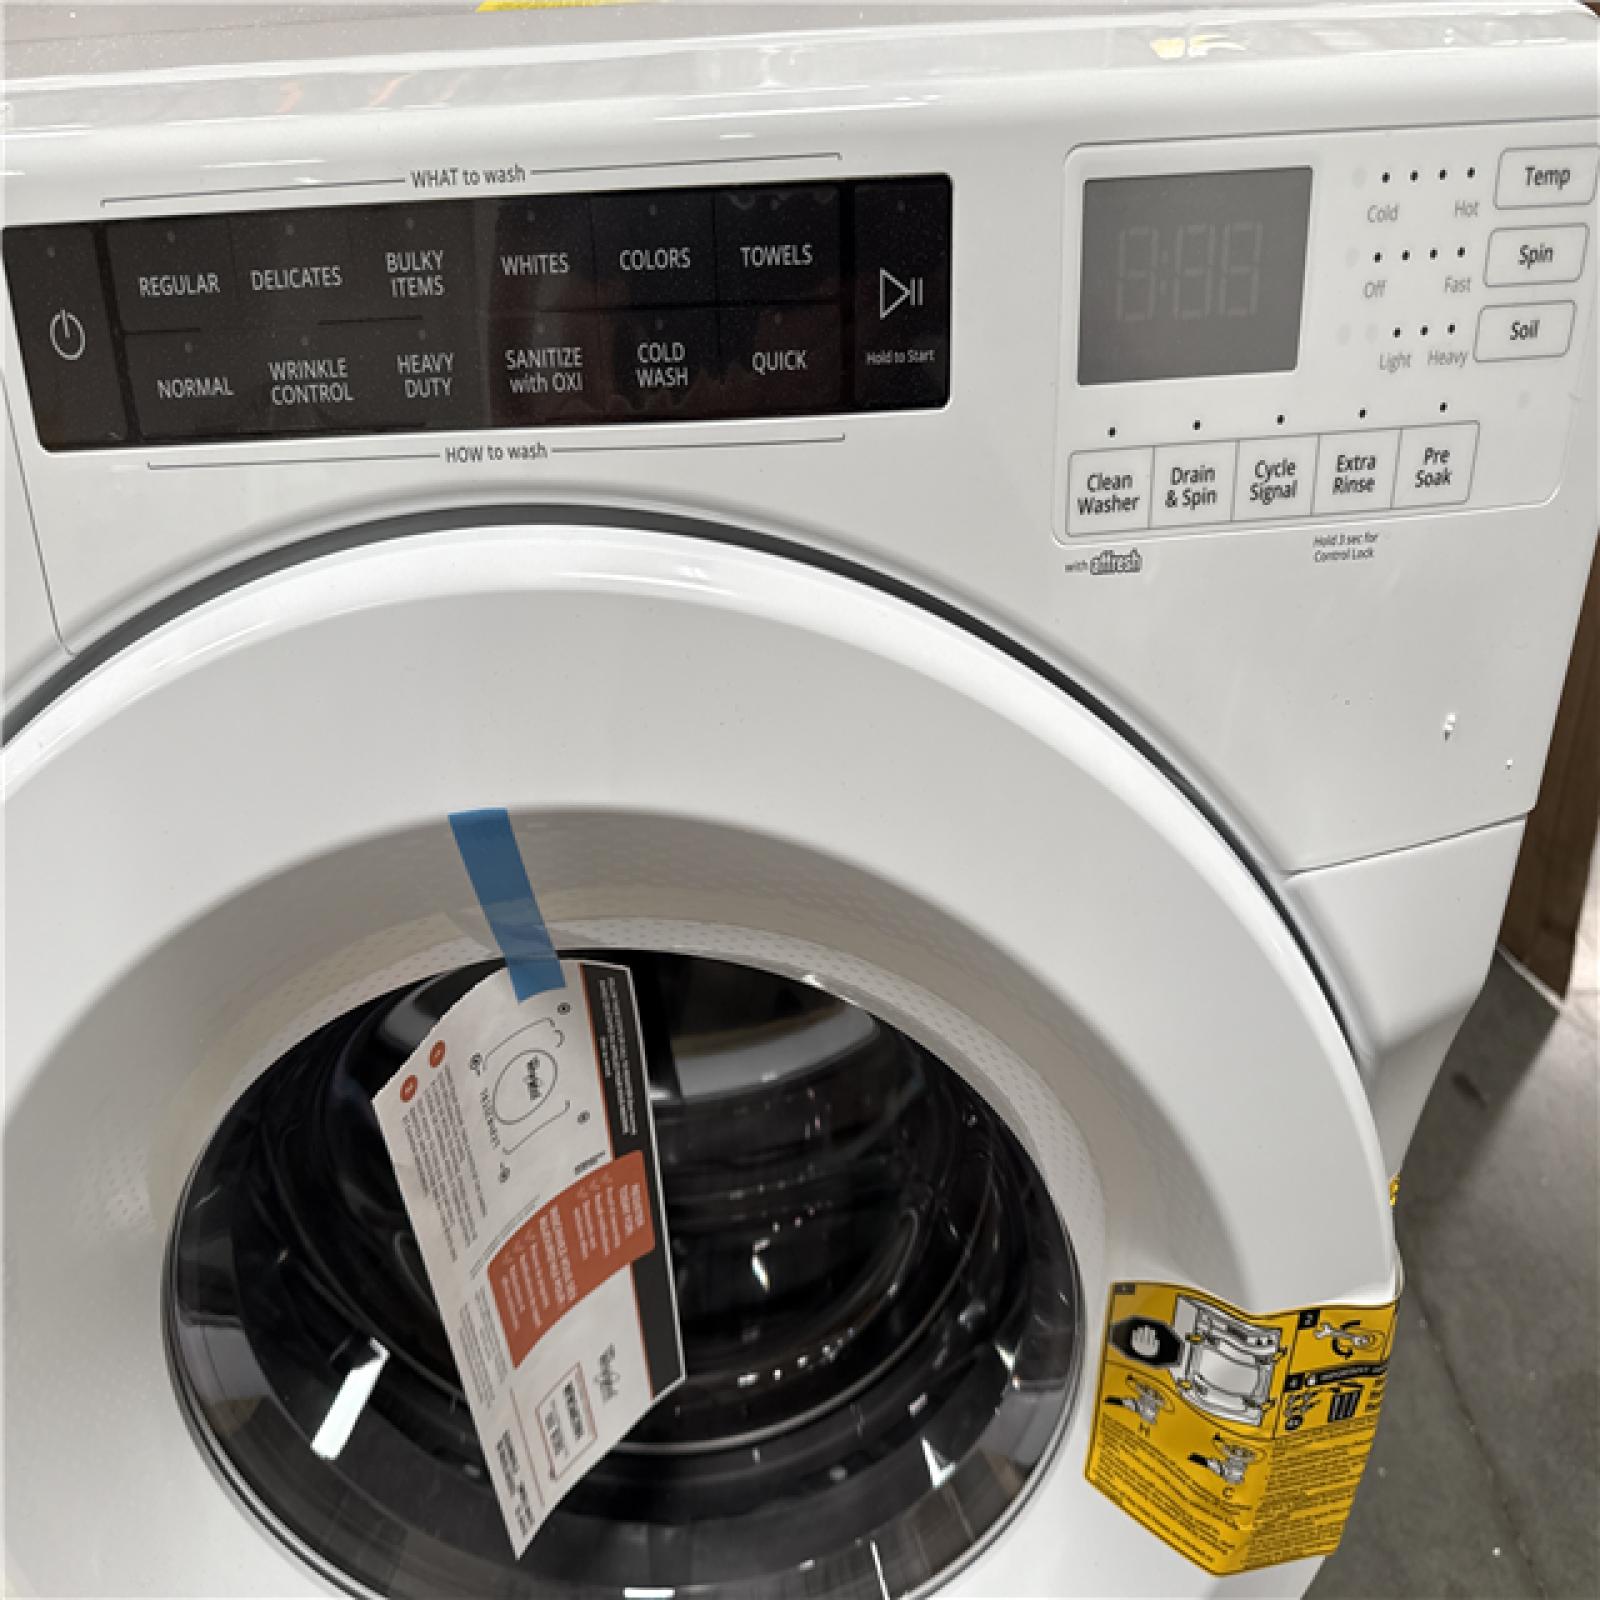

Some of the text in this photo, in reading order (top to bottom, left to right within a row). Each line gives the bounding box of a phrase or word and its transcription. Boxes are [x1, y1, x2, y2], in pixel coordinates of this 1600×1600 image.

[410, 162, 525, 188] WHAT to wash
[1525, 166, 1571, 189] Temp
[1367, 204, 1399, 223] Cold
[1454, 200, 1479, 218] Hot
[386, 250, 444, 273] BULKY
[501, 253, 570, 276] WHITES
[620, 247, 691, 271] COLORS
[740, 244, 813, 267] TOWELS
[1518, 243, 1554, 268] Spin
[139, 272, 220, 297] REGULAR
[251, 265, 343, 292] DELICATES
[391, 275, 445, 298] ITEMS
[1364, 278, 1388, 299] Off
[1444, 275, 1471, 294] Fast
[1510, 319, 1541, 340] Soil
[397, 352, 455, 375] HEAVY
[505, 347, 583, 370] SANITIZE
[637, 342, 686, 364] COLD
[752, 350, 807, 374] QUICK
[866, 349, 936, 365] Hold to Start
[1379, 350, 1412, 372] Light
[1427, 348, 1469, 369] Heavy
[268, 357, 349, 381] WRINKLE
[636, 366, 689, 388] WASH
[156, 377, 235, 399] NORMAL
[271, 382, 354, 405] CONTROL
[405, 378, 452, 398] DUTY
[510, 371, 583, 394] with OXI
[445, 441, 548, 463] HOW to wash
[1424, 446, 1450, 465] Pre
[1254, 458, 1296, 480] Cycle
[1336, 454, 1377, 473] Extra
[1087, 472, 1133, 491] Clean
[1171, 465, 1216, 485] Drain
[1333, 475, 1376, 494] Rinse
[1415, 468, 1452, 488] Soak
[1165, 487, 1218, 510] & Spin
[1250, 480, 1298, 503] Signal
[1077, 493, 1140, 515] Washer
[1314, 548, 1350, 562] Control
